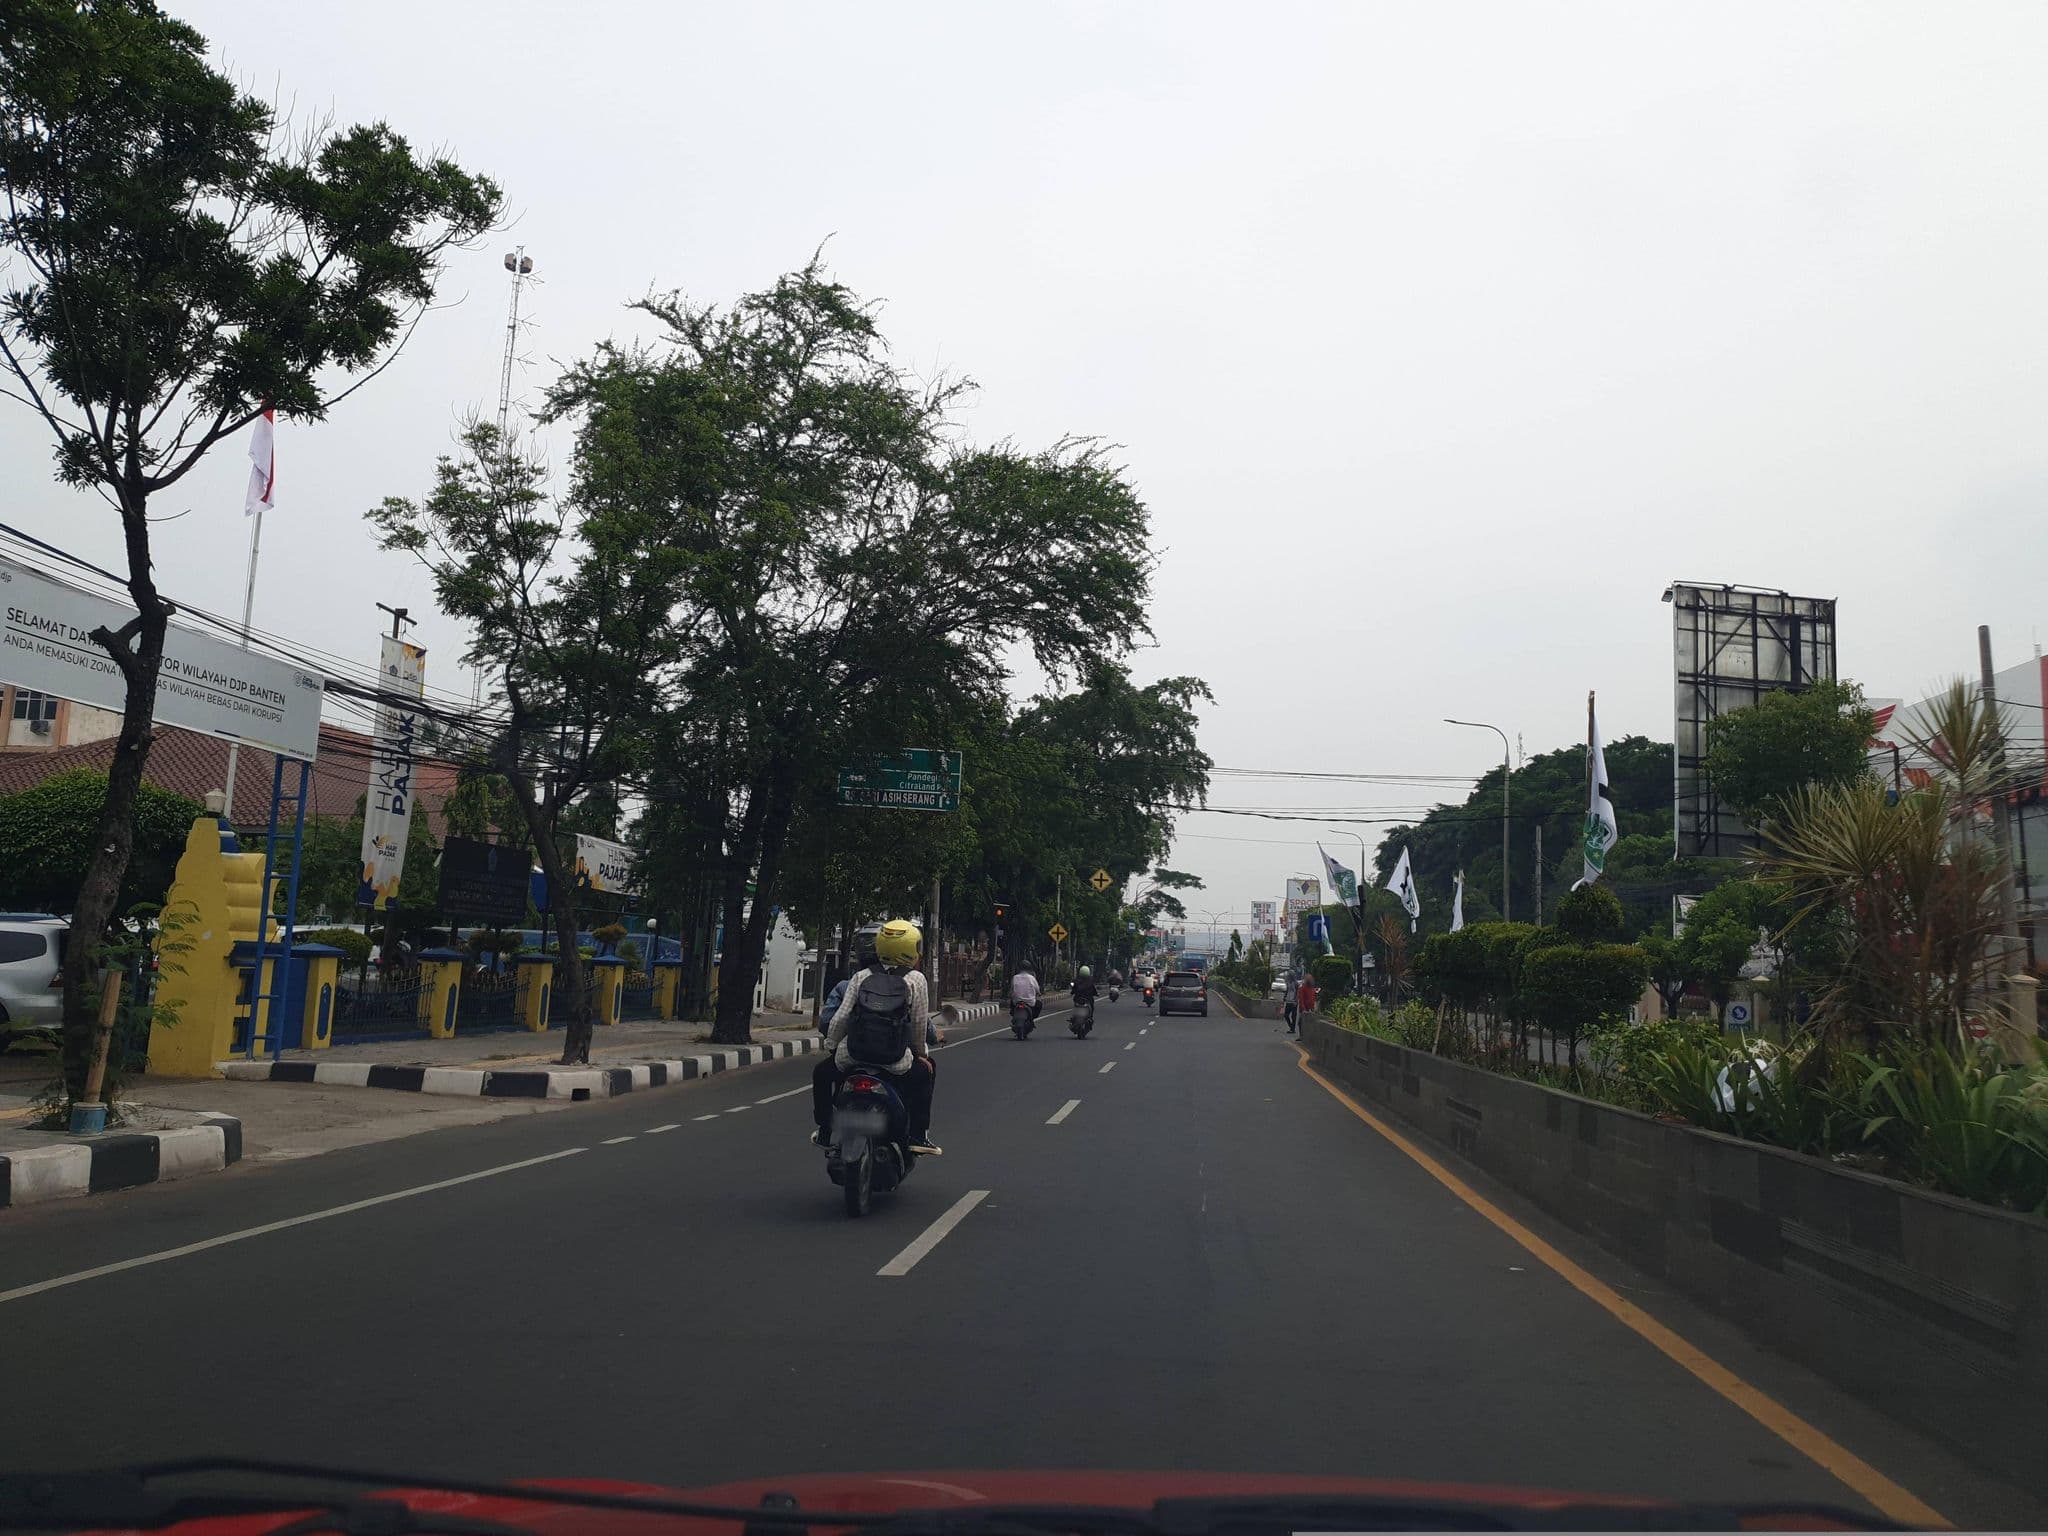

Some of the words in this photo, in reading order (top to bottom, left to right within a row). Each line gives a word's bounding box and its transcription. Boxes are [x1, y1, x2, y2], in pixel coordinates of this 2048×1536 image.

[3, 634, 34, 652] ANDA
[36, 644, 89, 668] MEMASUKI
[90, 660, 117, 677] ZONA
[169, 682, 205, 699] WILAYAH
[207, 693, 232, 709] BEBAS
[233, 702, 251, 714] DARI
[251, 707, 283, 723] KORUPSI
[6, 607, 67, 637] SELAMAT
[182, 663, 227, 687] WILAYAH
[229, 678, 248, 692] DJP
[249, 684, 286, 705] BANTEN
[391, 712, 415, 816] PAJAK
[882, 791, 901, 803] ASIH
[902, 792, 935, 805] SERANG
